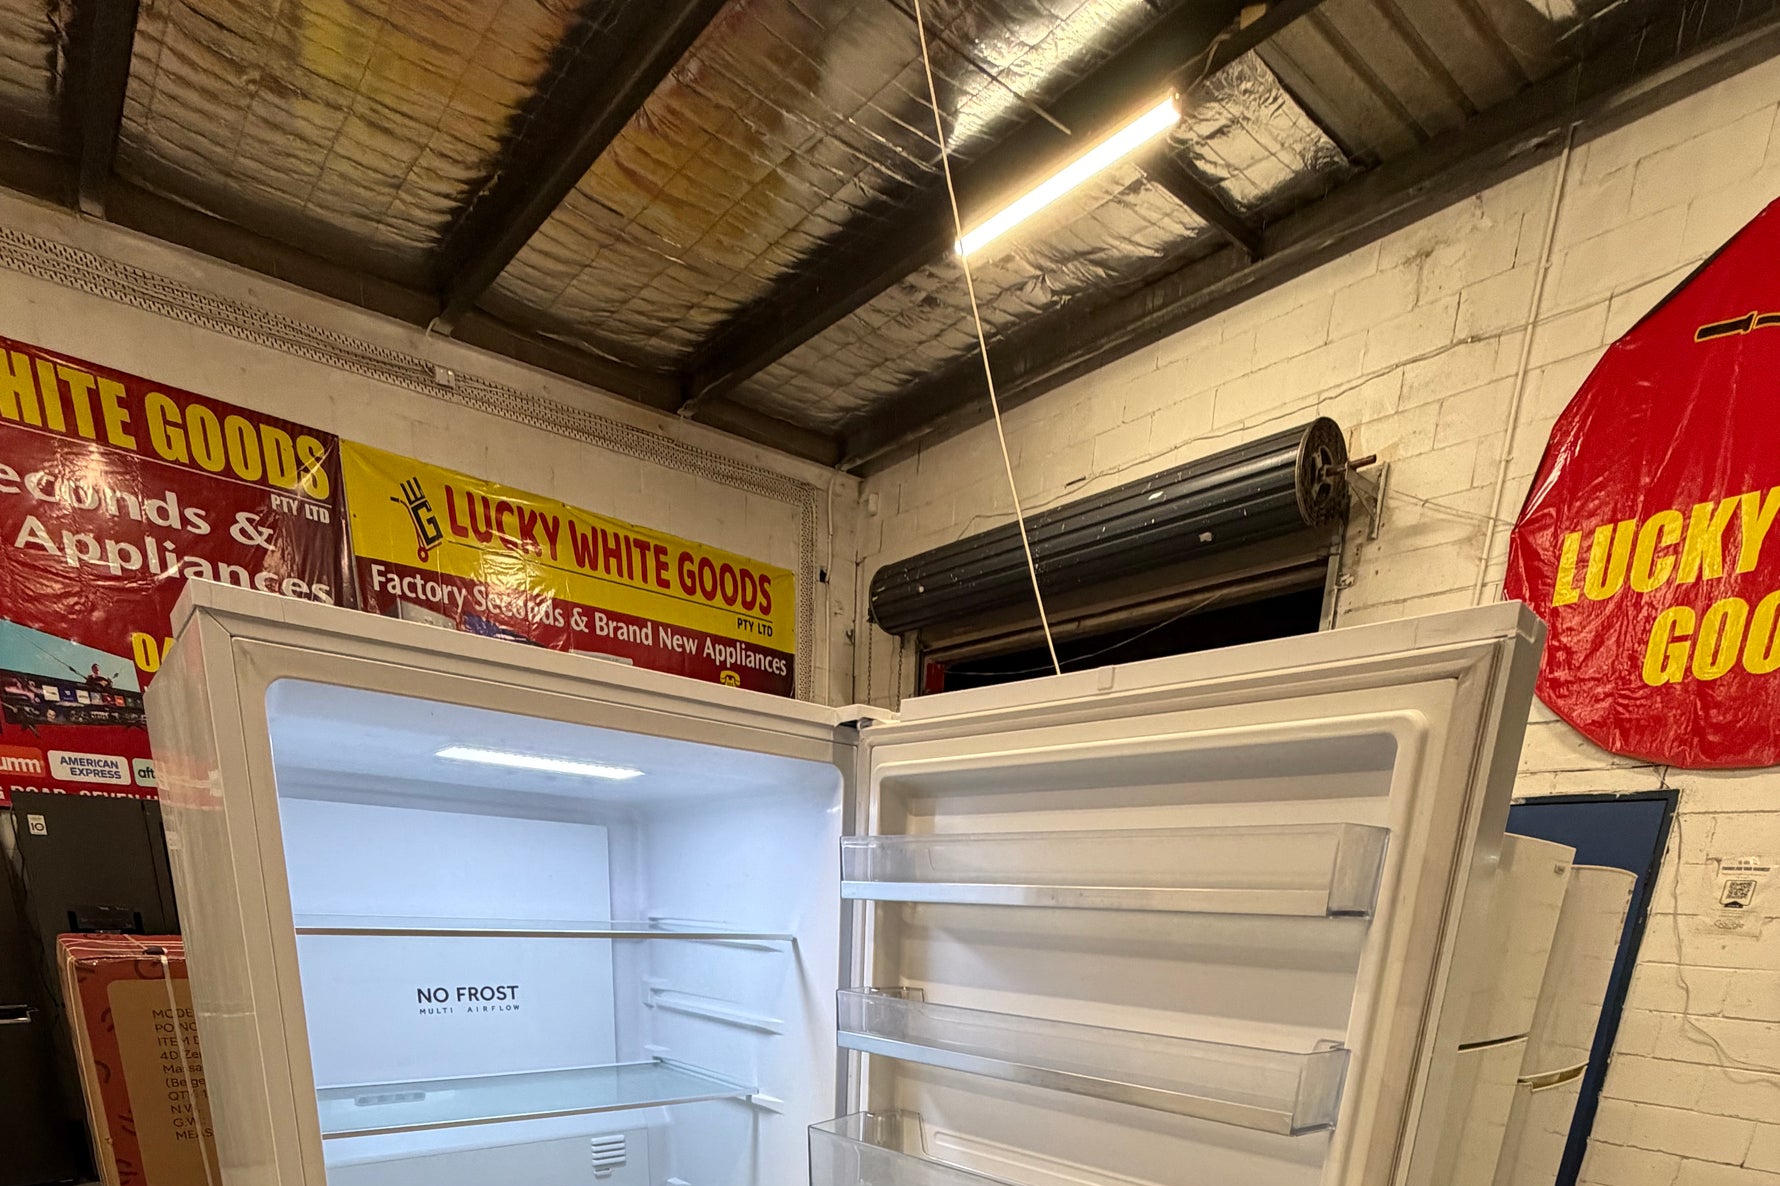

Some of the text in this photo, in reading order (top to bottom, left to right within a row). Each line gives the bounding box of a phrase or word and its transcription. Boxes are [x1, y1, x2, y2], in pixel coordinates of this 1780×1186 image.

[0, 348, 329, 500] HITE GOODS
[271, 494, 330, 524] PTY LTD
[229, 511, 276, 551] &
[14, 515, 335, 605] Appliances
[444, 485, 772, 616] LUCKY WHITE GOODS
[1552, 486, 1780, 607] LUCKY
[371, 564, 787, 676] Factory Seconds & Brand New Appliances
[737, 617, 773, 637] PTY LTD
[1642, 590, 1780, 687] GOO
[60, 755, 119, 769] AMERICAN
[70, 767, 122, 779] EXPRESS
[417, 985, 519, 1004] NO FROST
[419, 1004, 520, 1015] MULTI AIRFLOW
[163, 1063, 202, 1074] Masa
[165, 1078, 206, 1089] (Bege
